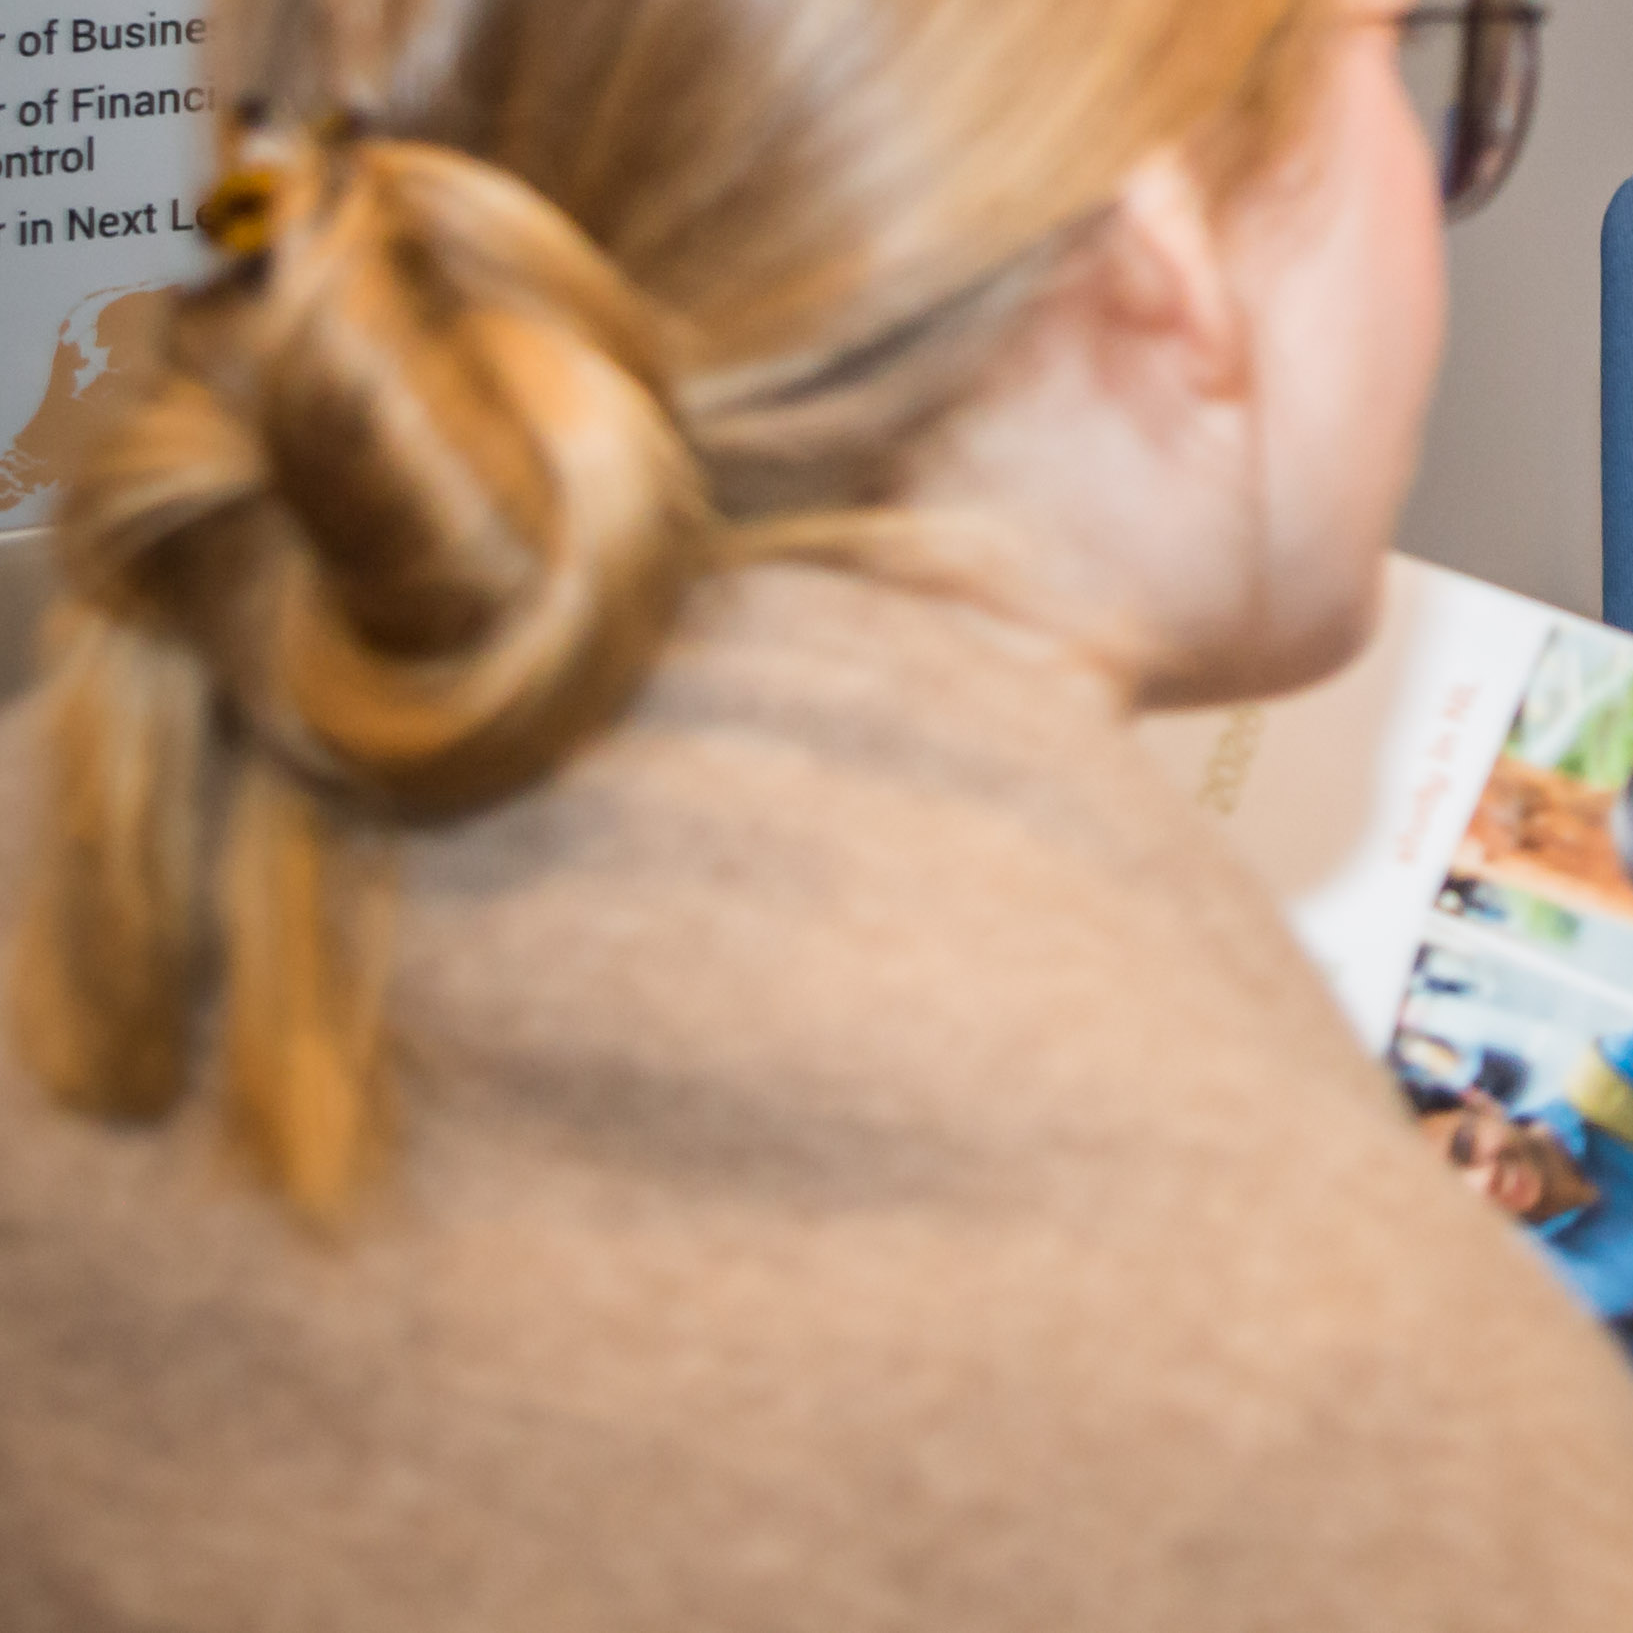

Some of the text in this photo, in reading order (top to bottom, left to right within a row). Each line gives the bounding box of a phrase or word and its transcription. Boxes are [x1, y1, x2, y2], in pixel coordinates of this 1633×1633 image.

[18, 20, 59, 57] of
[18, 91, 59, 127] of
[0, 137, 94, 178] ntrol
[18, 207, 54, 245] in
[67, 201, 156, 241] Next
